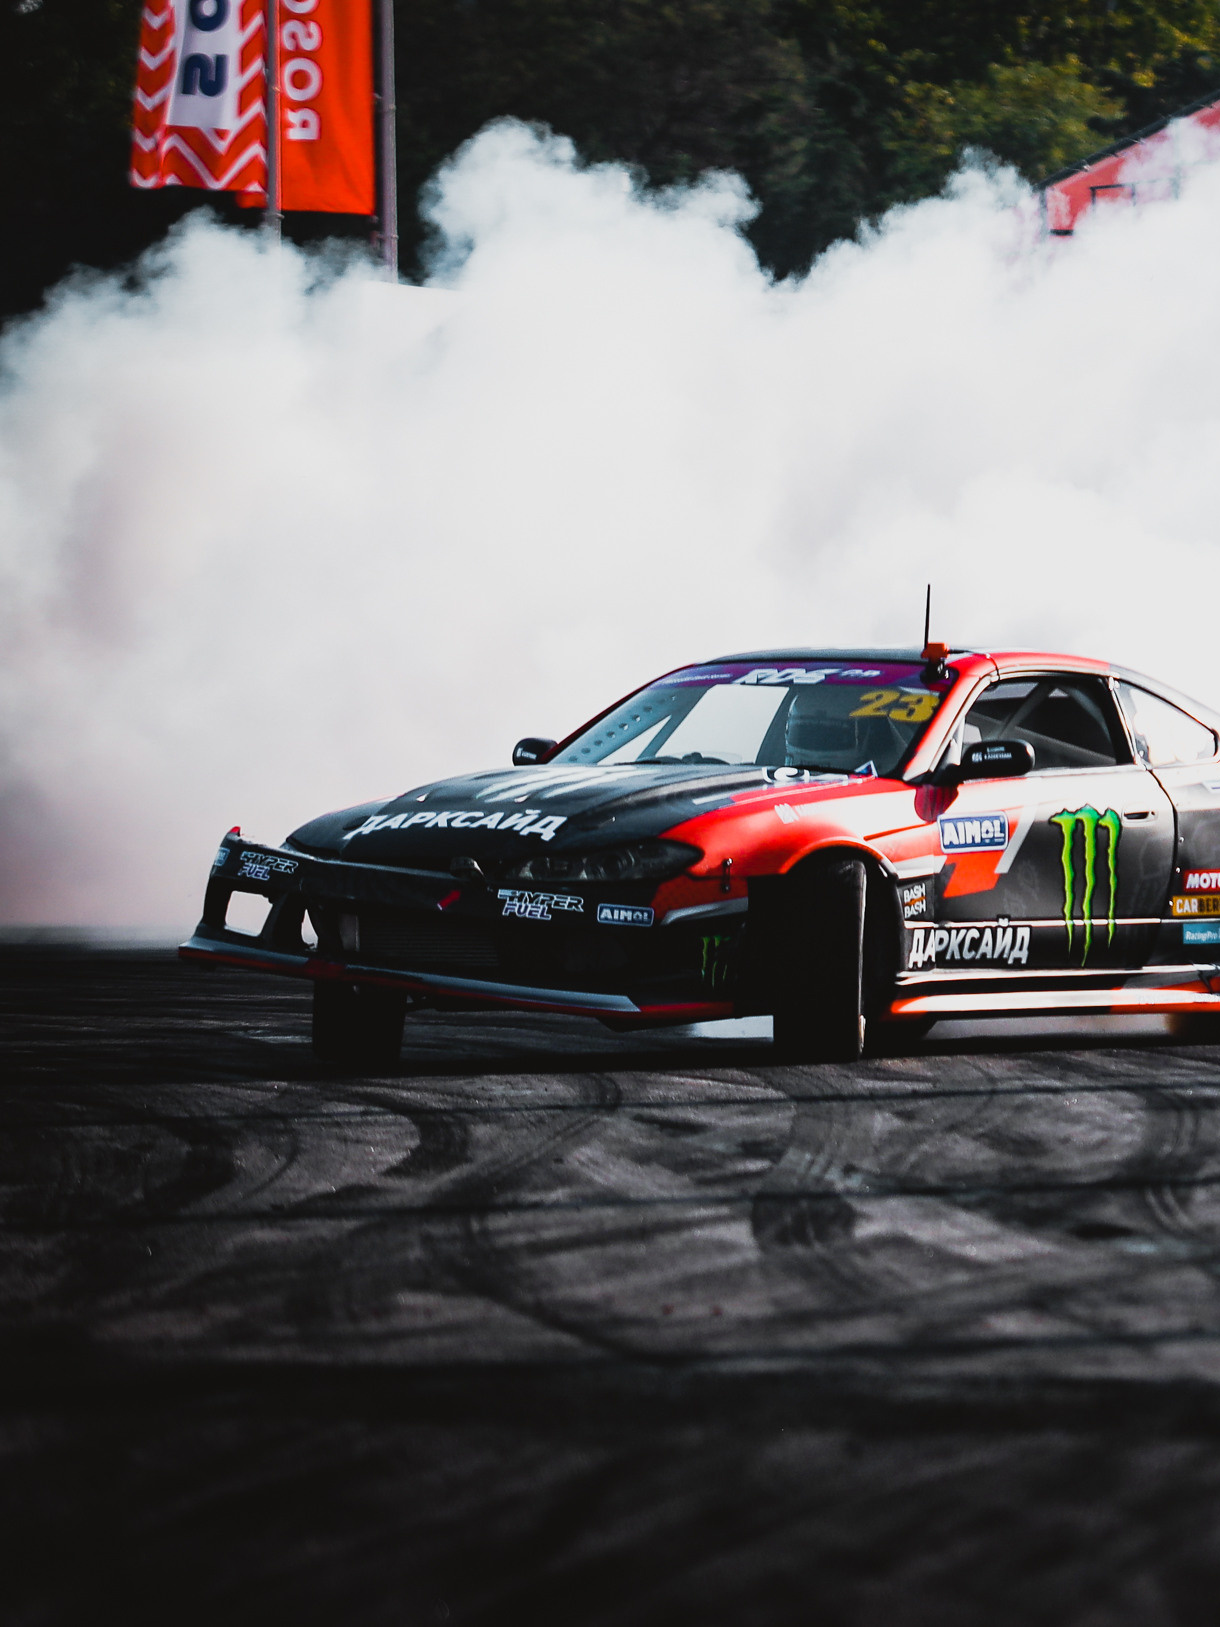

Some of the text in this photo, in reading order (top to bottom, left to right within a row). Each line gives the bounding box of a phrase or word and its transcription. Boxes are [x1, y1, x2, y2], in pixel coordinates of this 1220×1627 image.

[850, 690, 940, 722] 23
[342, 809, 568, 841] ДАРКСАЙД
[943, 819, 1005, 846] AIMOL
[237, 862, 270, 881] FUEL
[240, 850, 299, 875] HYPER
[497, 888, 585, 912] HYPER
[903, 882, 926, 904] BASH
[502, 902, 552, 921] FUEL
[600, 907, 649, 922] AIMOL
[904, 901, 926, 919] BASH
[908, 917, 1031, 969] ДАРКСАЙД
